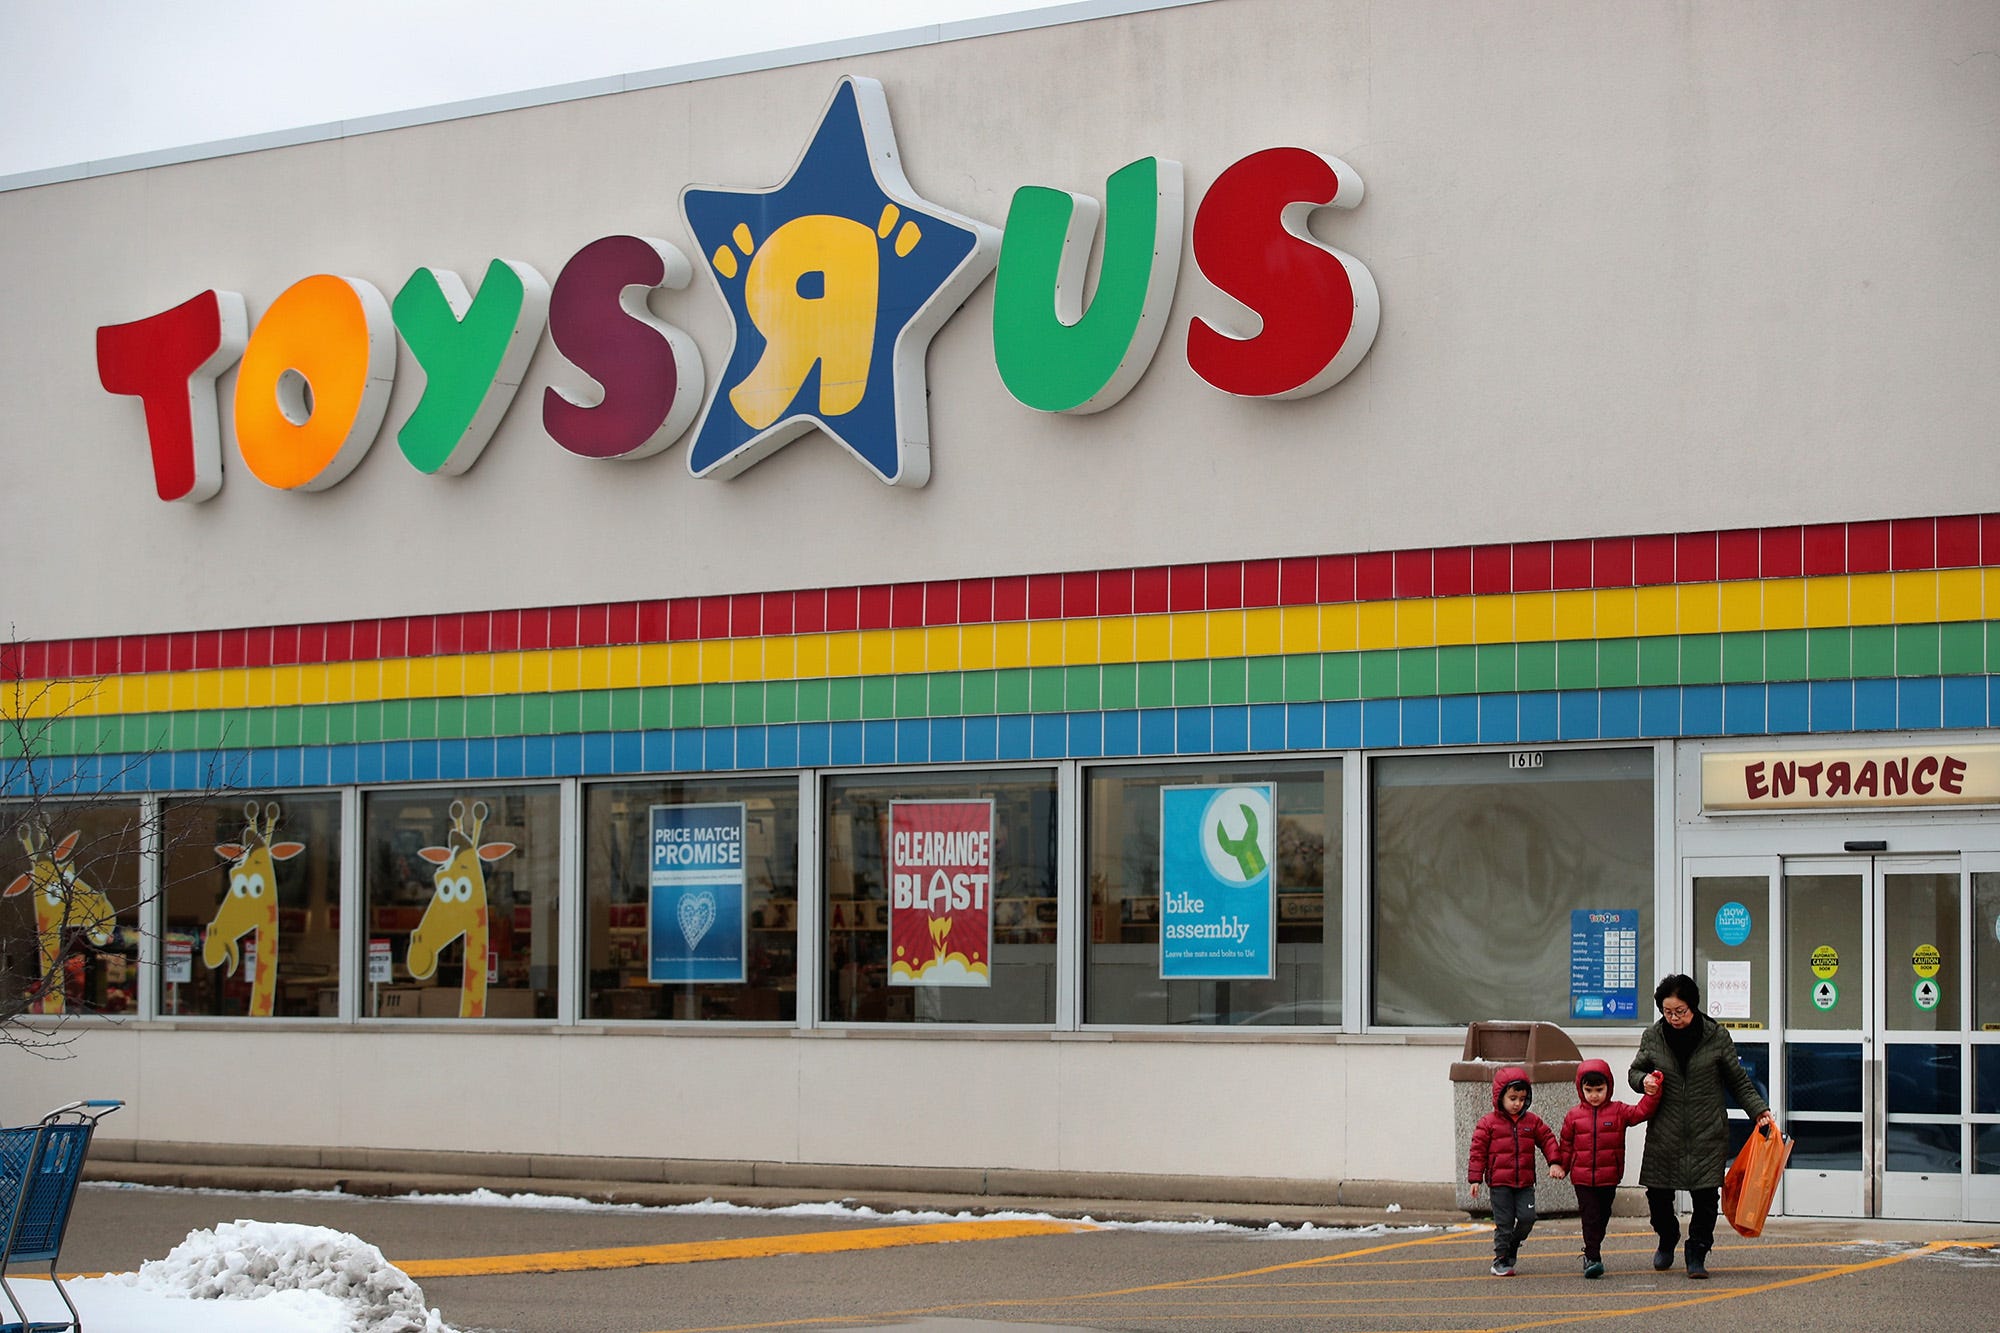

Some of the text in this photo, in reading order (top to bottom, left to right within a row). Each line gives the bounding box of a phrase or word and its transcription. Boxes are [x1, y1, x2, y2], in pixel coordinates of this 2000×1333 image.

[97, 234, 706, 500] TOYS
[992, 147, 1380, 414] US
[1511, 752, 1543, 767] 1610
[1745, 756, 1967, 799] ENTRANCE
[655, 826, 740, 843] PRICE MATCH
[655, 842, 740, 864] PROMISE
[894, 831, 989, 867] CLEARANCE
[894, 868, 989, 913] BLAST
[1165, 891, 1205, 914] bike
[1723, 908, 1745, 916] now
[1165, 915, 1250, 944] assembly
[1719, 914, 1749, 928] hiring!
[1165, 950, 1181, 958] Leave
[1183, 949, 1193, 957] the
[1209, 949, 1220, 957] and
[1221, 948, 1236, 957] bolts
[1237, 949, 1244, 957] to
